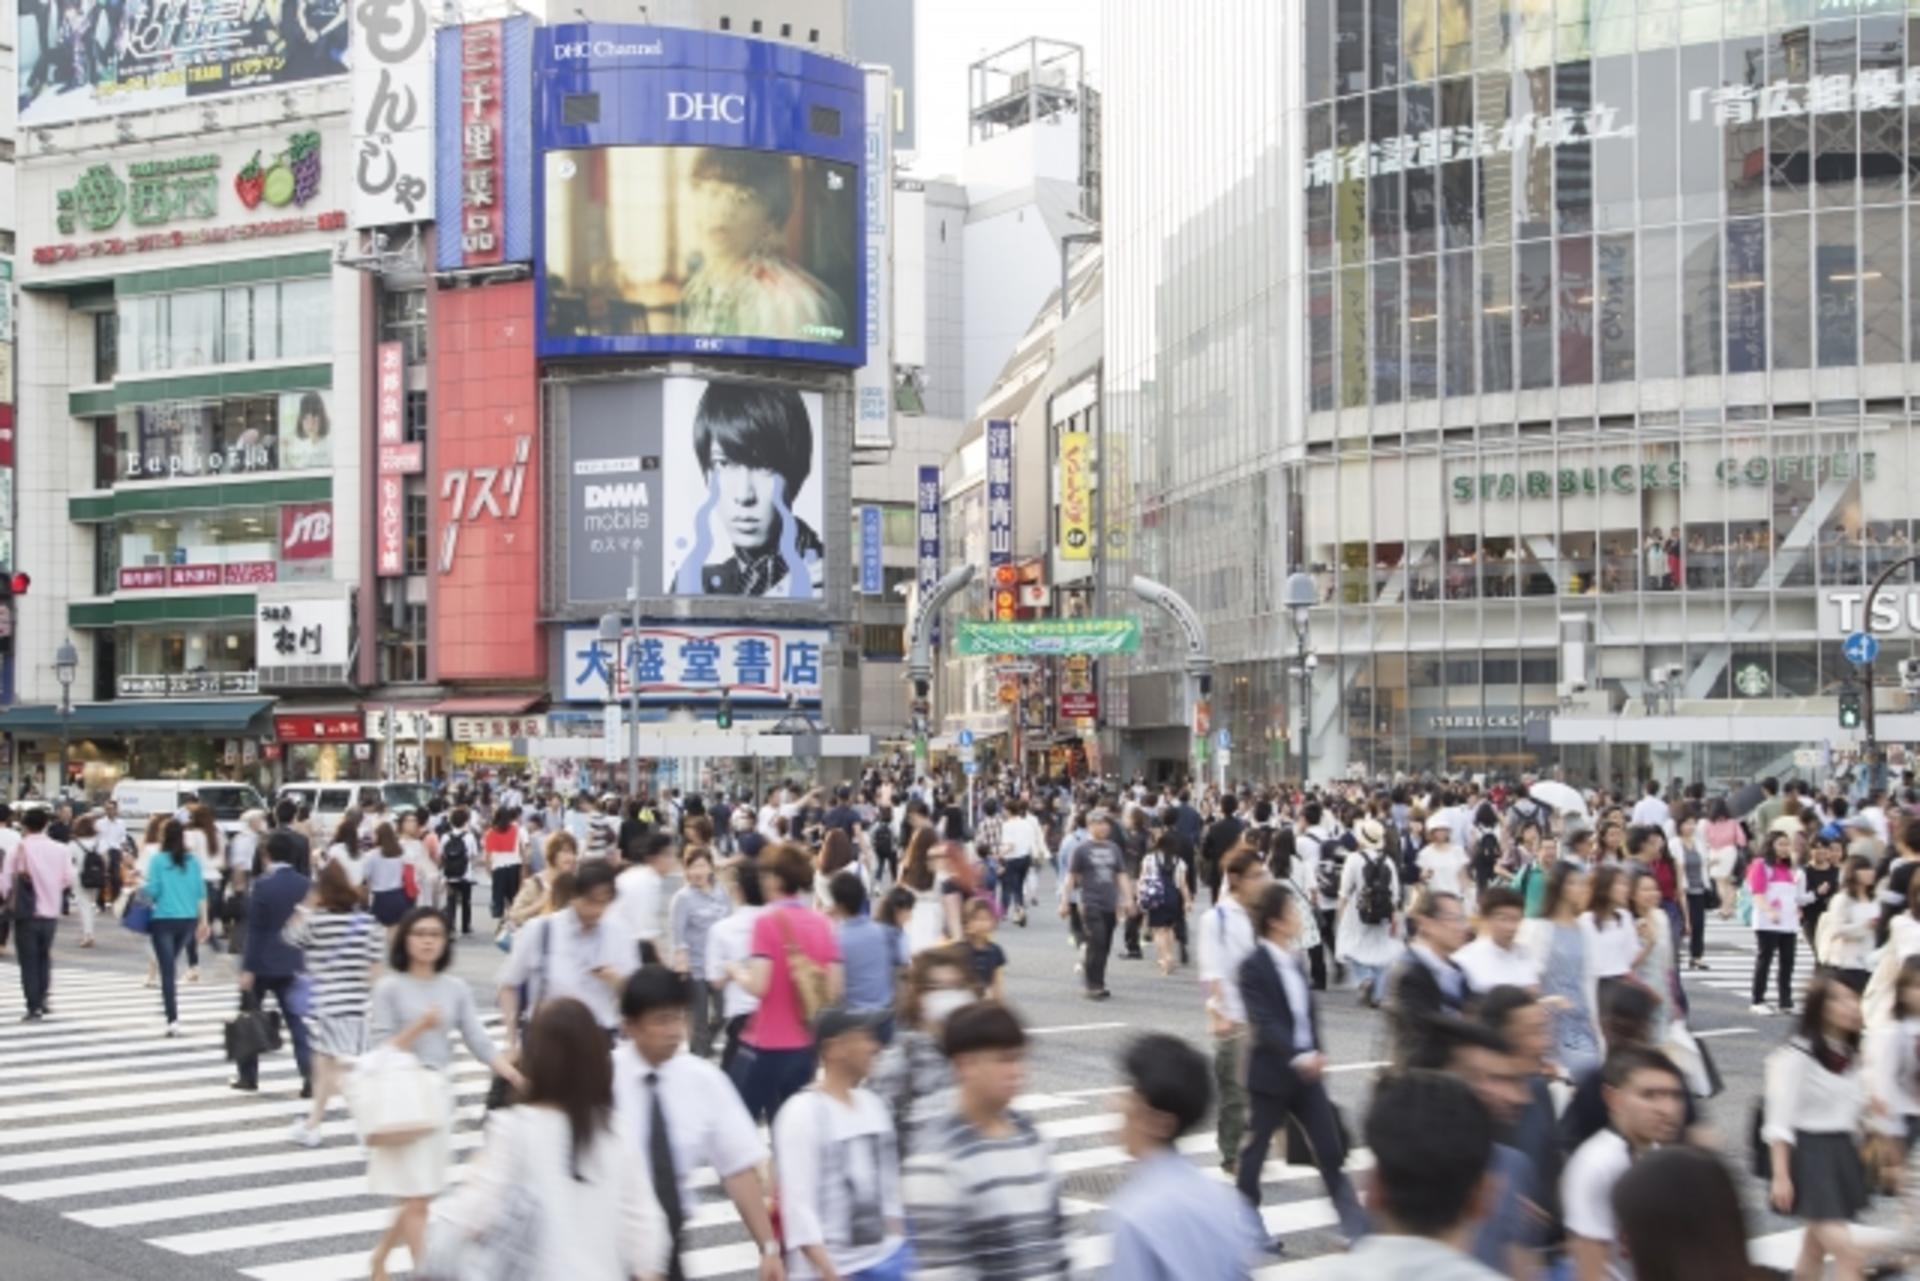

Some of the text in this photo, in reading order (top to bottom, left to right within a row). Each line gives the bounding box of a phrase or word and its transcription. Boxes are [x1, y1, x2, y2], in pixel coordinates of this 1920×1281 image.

[554, 40, 663, 60] DHC Channel
[667, 91, 746, 124] DHC
[1453, 452, 1877, 501] STARBUCKS COFFEE
[438, 434, 532, 575] クスリ
[585, 483, 648, 508] DMM
[285, 512, 330, 548] JTB
[584, 510, 650, 532] mobile
[590, 536, 645, 552] のスマホ
[575, 638, 820, 686] 大盛堂書店
